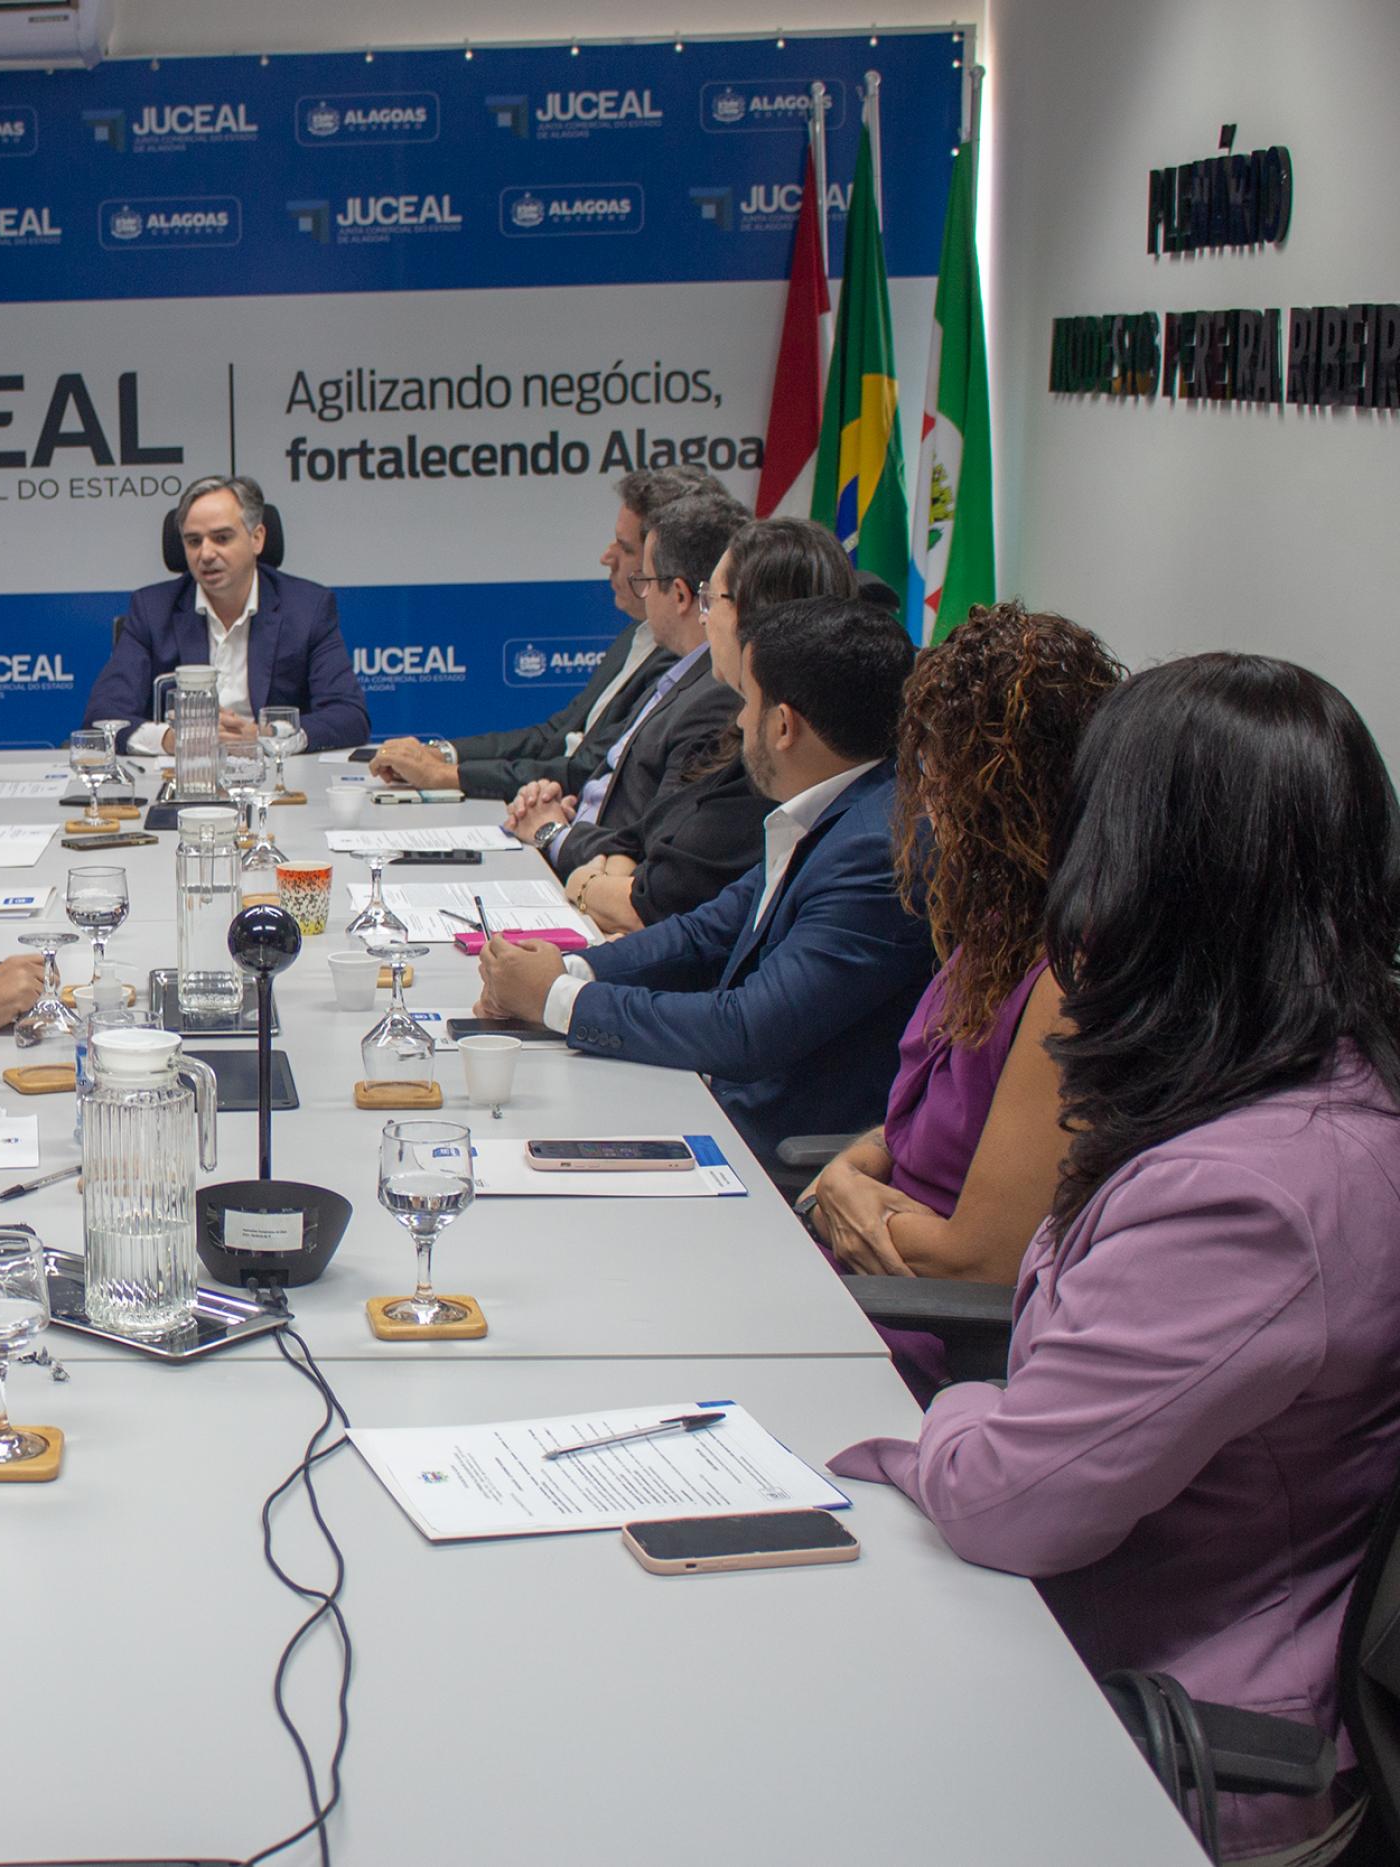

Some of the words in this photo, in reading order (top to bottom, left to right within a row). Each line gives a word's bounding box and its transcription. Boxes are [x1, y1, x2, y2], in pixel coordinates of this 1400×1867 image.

[343, 107, 427, 125] ALAGOAS
[536, 90, 662, 121] JUCEAL
[749, 95, 832, 112] ALAGOS
[132, 103, 259, 135] JUCEAL
[336, 194, 464, 226] JUCEAL
[548, 198, 632, 216] ALAGOAS
[740, 183, 854, 214] JUCA
[146, 211, 229, 229] ALAGOAS
[286, 363, 510, 421] Agilizando
[522, 359, 723, 415] negócios,
[285, 429, 590, 482] fortalecendo
[599, 428, 765, 474] Alagoa
[17, 477, 60, 500] DO
[69, 475, 183, 498] ESTADO
[550, 652, 607, 667] ALAG
